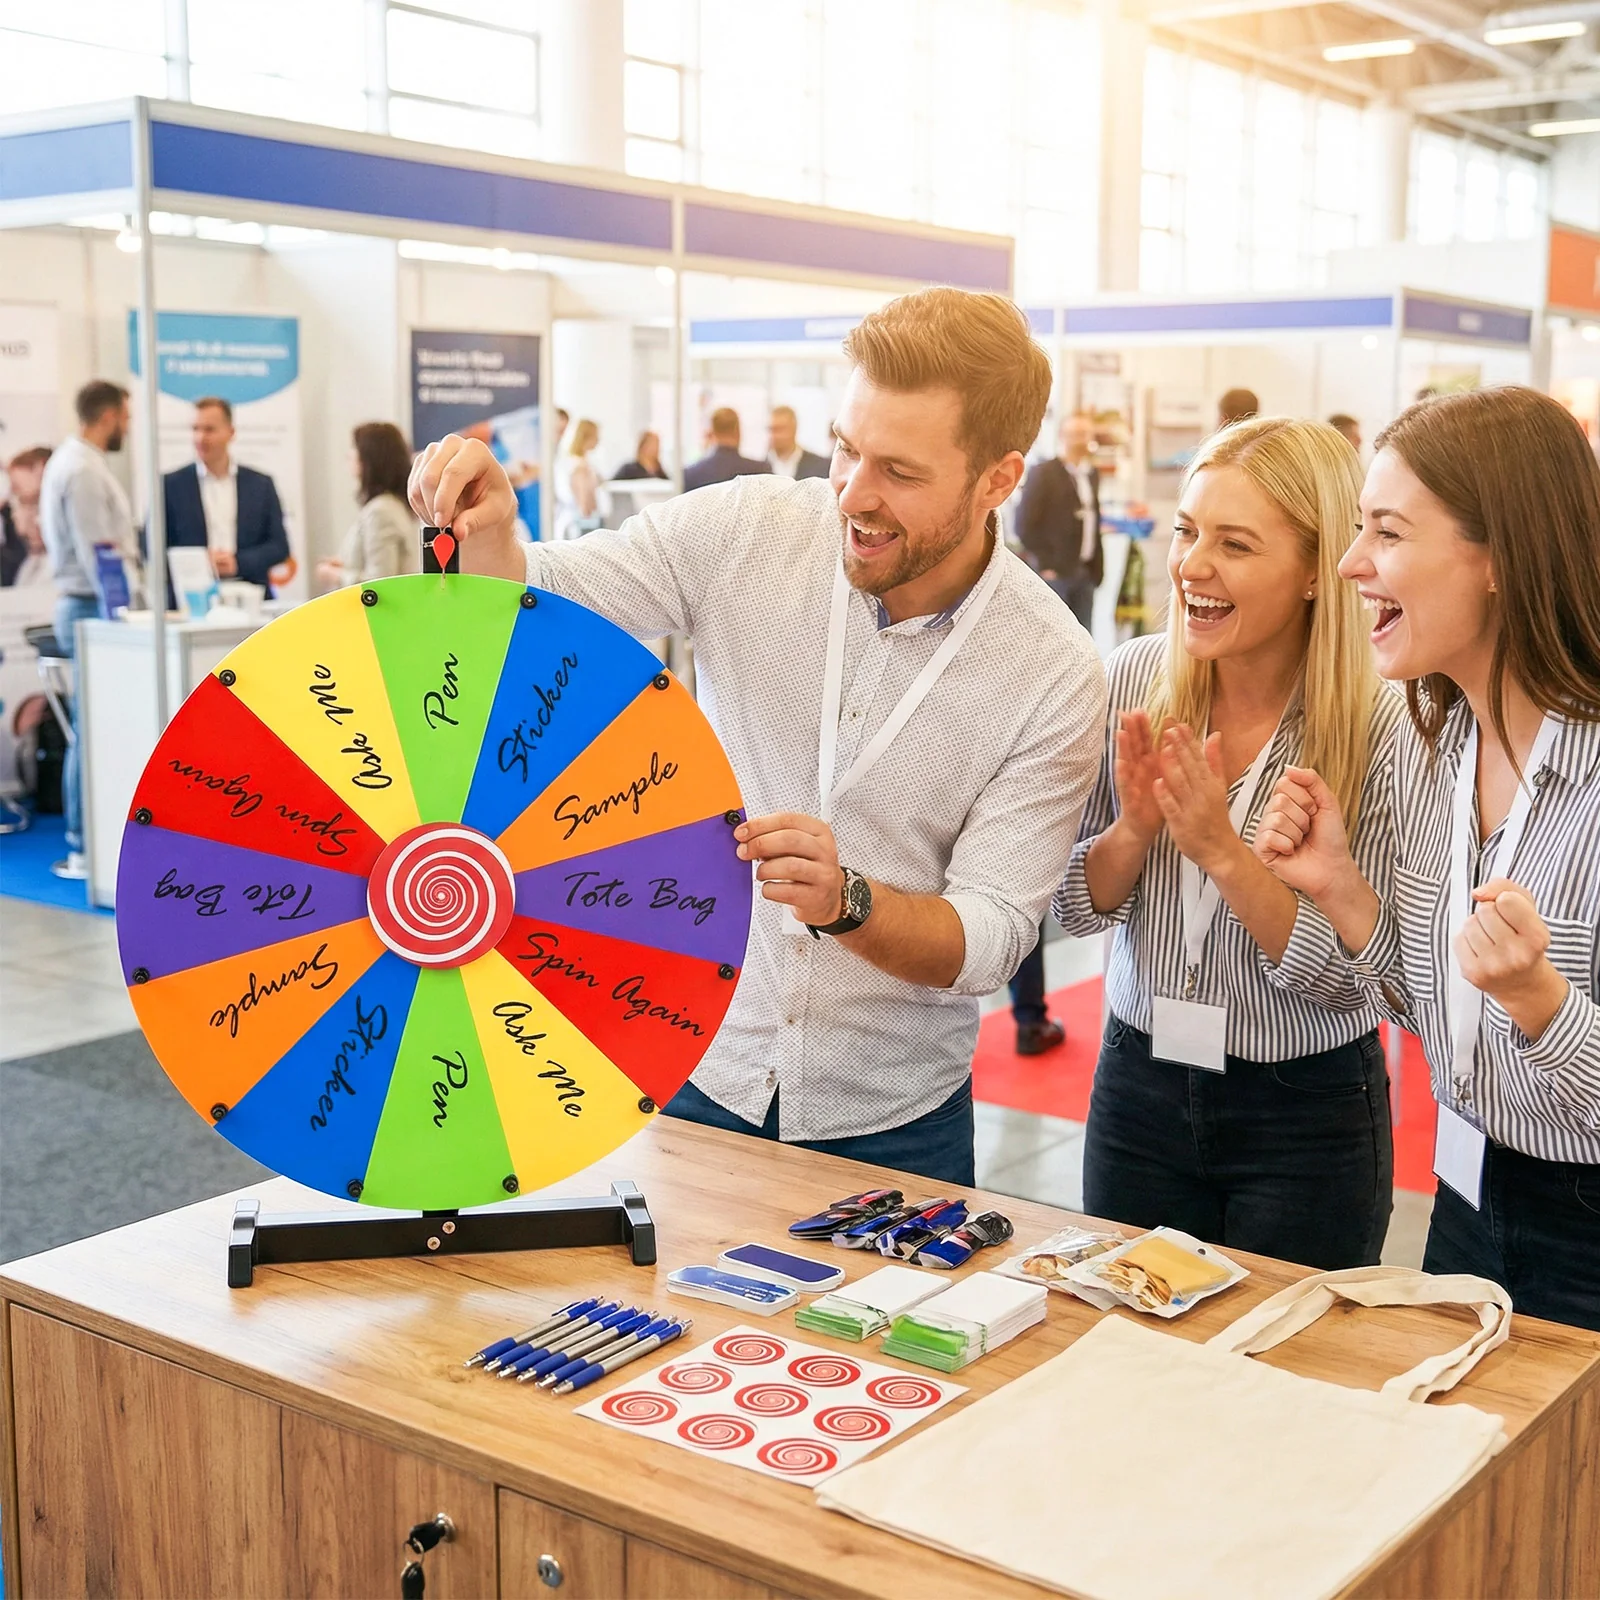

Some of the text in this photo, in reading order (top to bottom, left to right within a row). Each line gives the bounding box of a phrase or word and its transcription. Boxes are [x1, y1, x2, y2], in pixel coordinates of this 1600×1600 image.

[308, 663, 393, 790] Ask Me
[423, 652, 460, 730] Pen
[497, 651, 579, 783] Sticker
[169, 759, 357, 857] Spin Again
[554, 751, 679, 841] Sample
[153, 868, 316, 921] Tote Bag
[564, 871, 717, 926] Tote Bag
[208, 943, 339, 1039] Sample
[517, 932, 705, 1037] Spin Again
[310, 994, 388, 1132] Sticker
[431, 1050, 468, 1129] Pen
[492, 1001, 585, 1118] Ask Me
